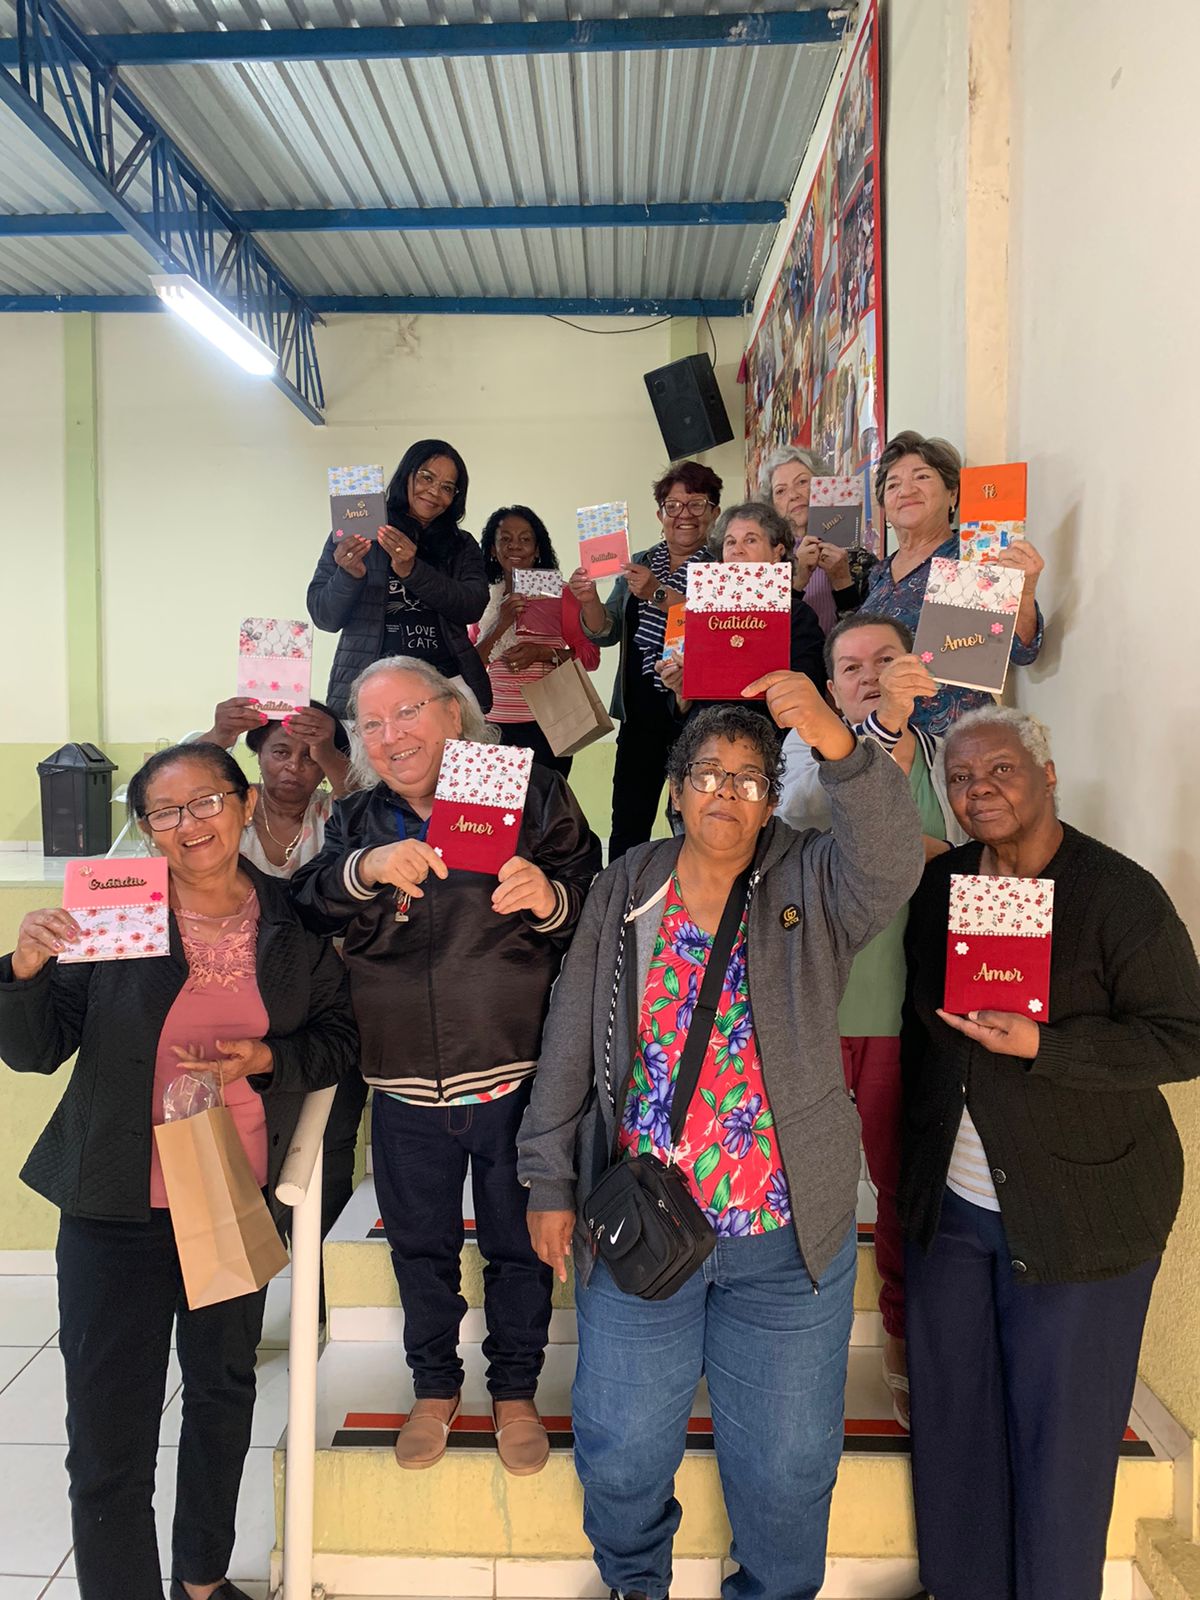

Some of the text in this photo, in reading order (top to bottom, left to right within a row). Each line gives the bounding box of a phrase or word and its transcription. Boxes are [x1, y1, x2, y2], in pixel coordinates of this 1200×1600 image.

[405, 624, 436, 637] LOVE
[708, 615, 767, 630] Gratidão
[407, 637, 438, 649] CATS
[940, 633, 985, 653] Amor
[449, 814, 494, 836] Amor
[973, 962, 1024, 983] Amor
